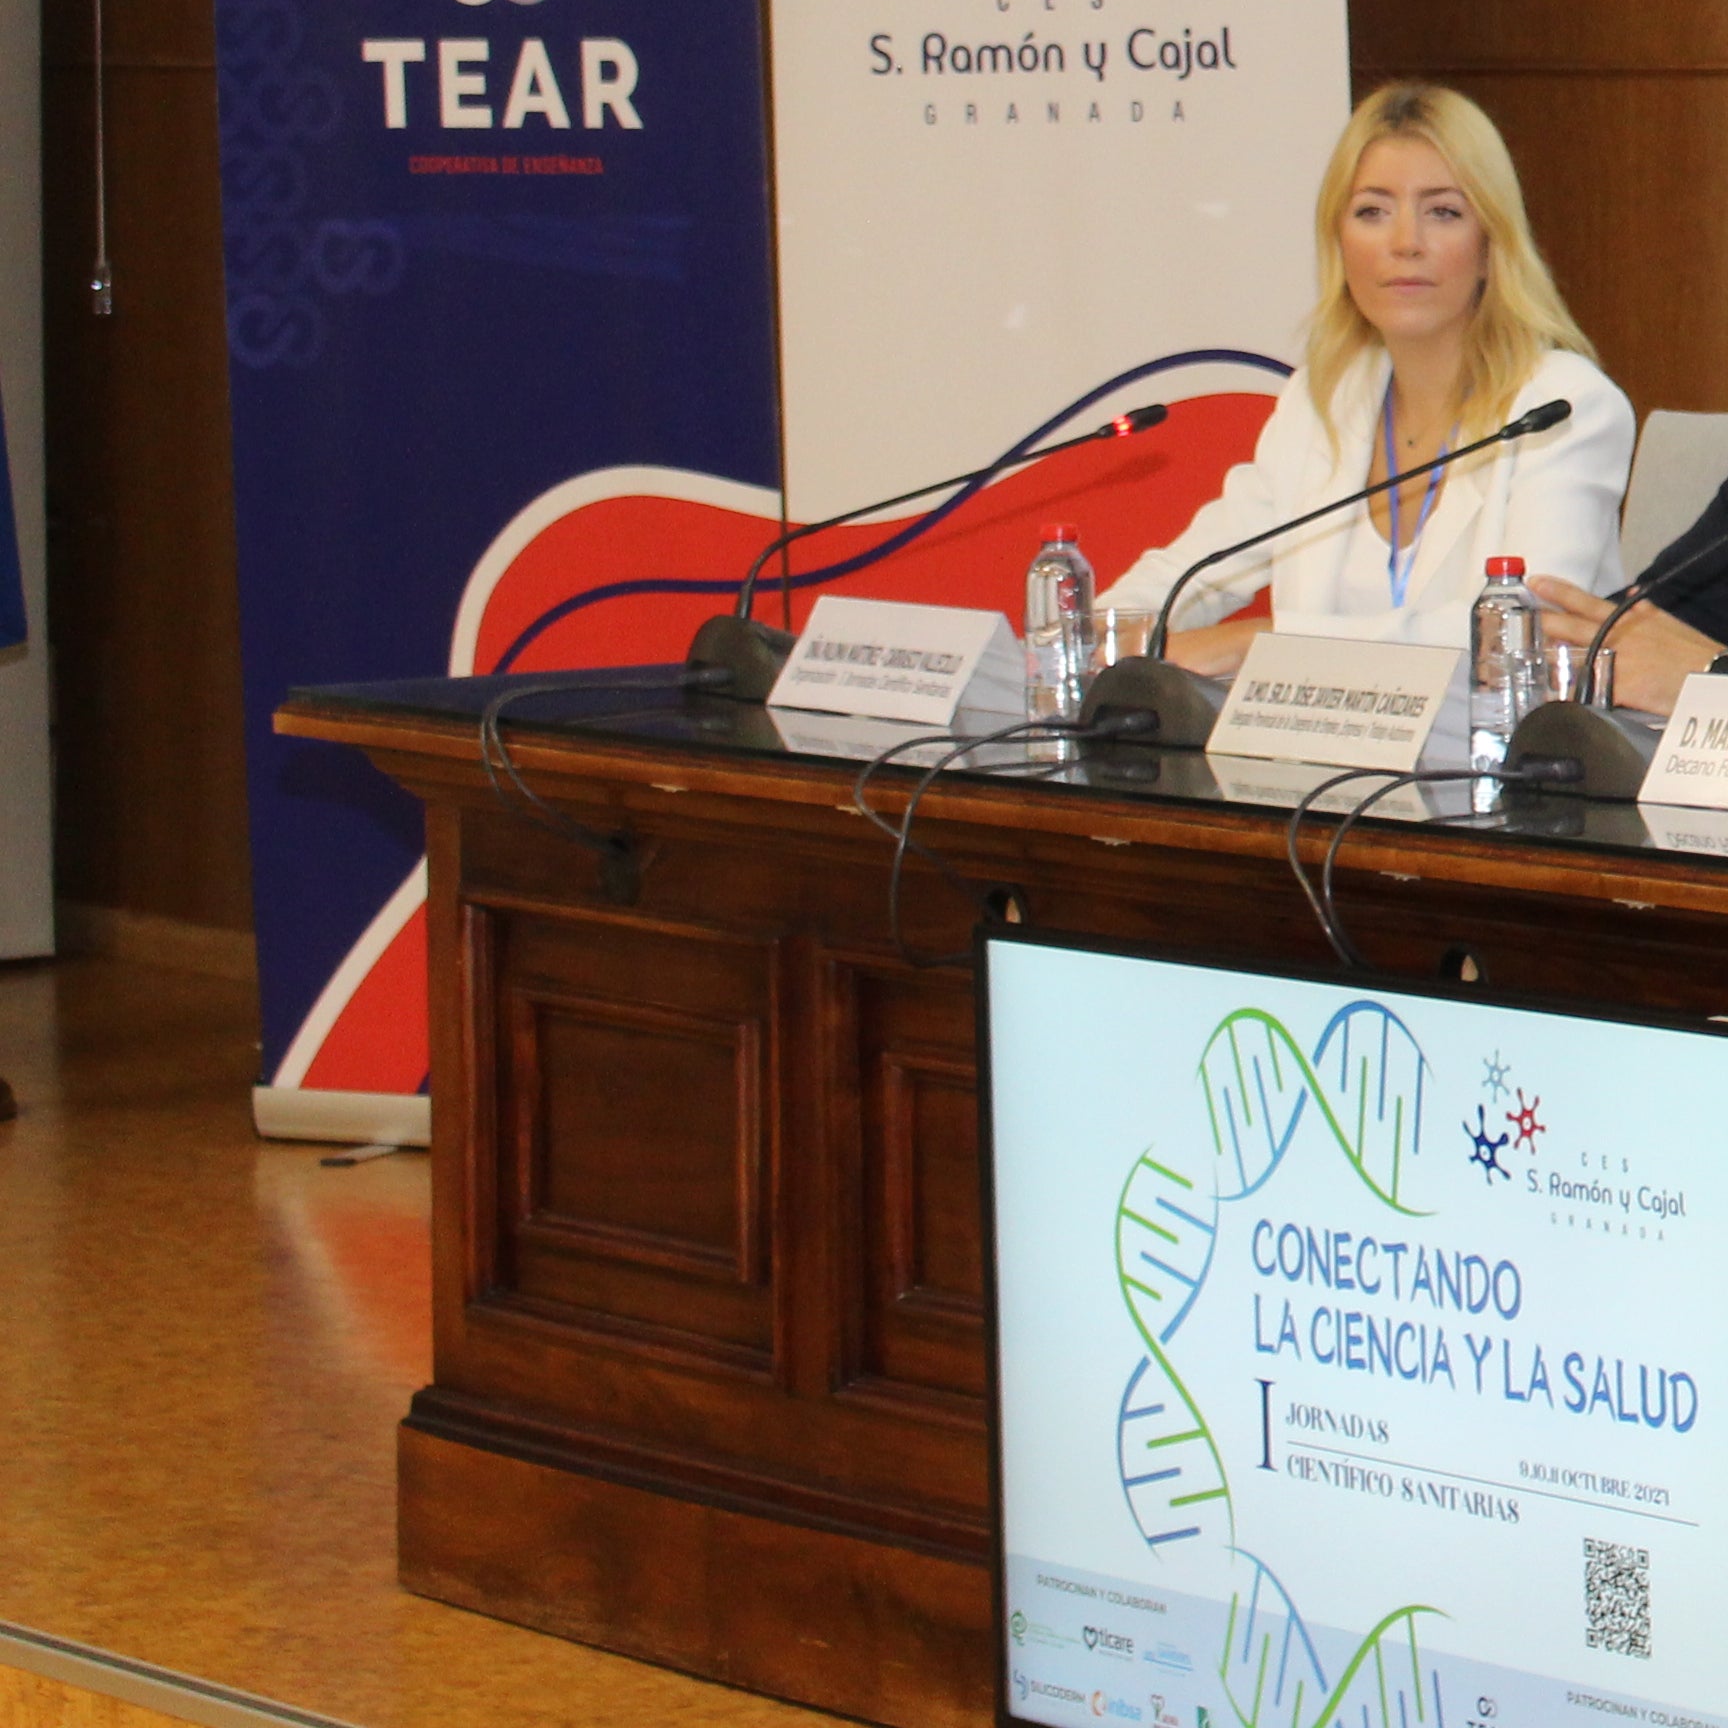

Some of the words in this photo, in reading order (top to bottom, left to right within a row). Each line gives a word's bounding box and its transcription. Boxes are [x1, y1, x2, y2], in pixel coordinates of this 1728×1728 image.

[869, 34, 902, 74] S.
[922, 32, 1065, 73] Ramón
[1083, 42, 1106, 81] y
[1128, 27, 1236, 79] Cajal
[362, 38, 643, 129] TEAR
[924, 101, 1185, 125] GRANADA
[1680, 717, 1697, 748] D.
[1665, 755, 1716, 775] Decano
[1526, 1168, 1543, 1193] S.
[1549, 1172, 1613, 1205] Ramón
[1619, 1190, 1630, 1214] y
[1637, 1186, 1687, 1219] Cajal
[1252, 1219, 1522, 1321] CONECTANDO
[1253, 1293, 1300, 1359] LA
[1309, 1307, 1456, 1391] CIENCIA
[1463, 1334, 1494, 1394] Y
[1504, 1340, 1556, 1410] LA
[1563, 1352, 1699, 1434] SALUD
[1254, 1378, 1278, 1472] I
[1286, 1403, 1390, 1444] JORNADAS
[1287, 1454, 1393, 1497] CIENTÍFICO
[1402, 1476, 1520, 1523] SANITARIAS
[1562, 1469, 1631, 1499] OCTUBRE
